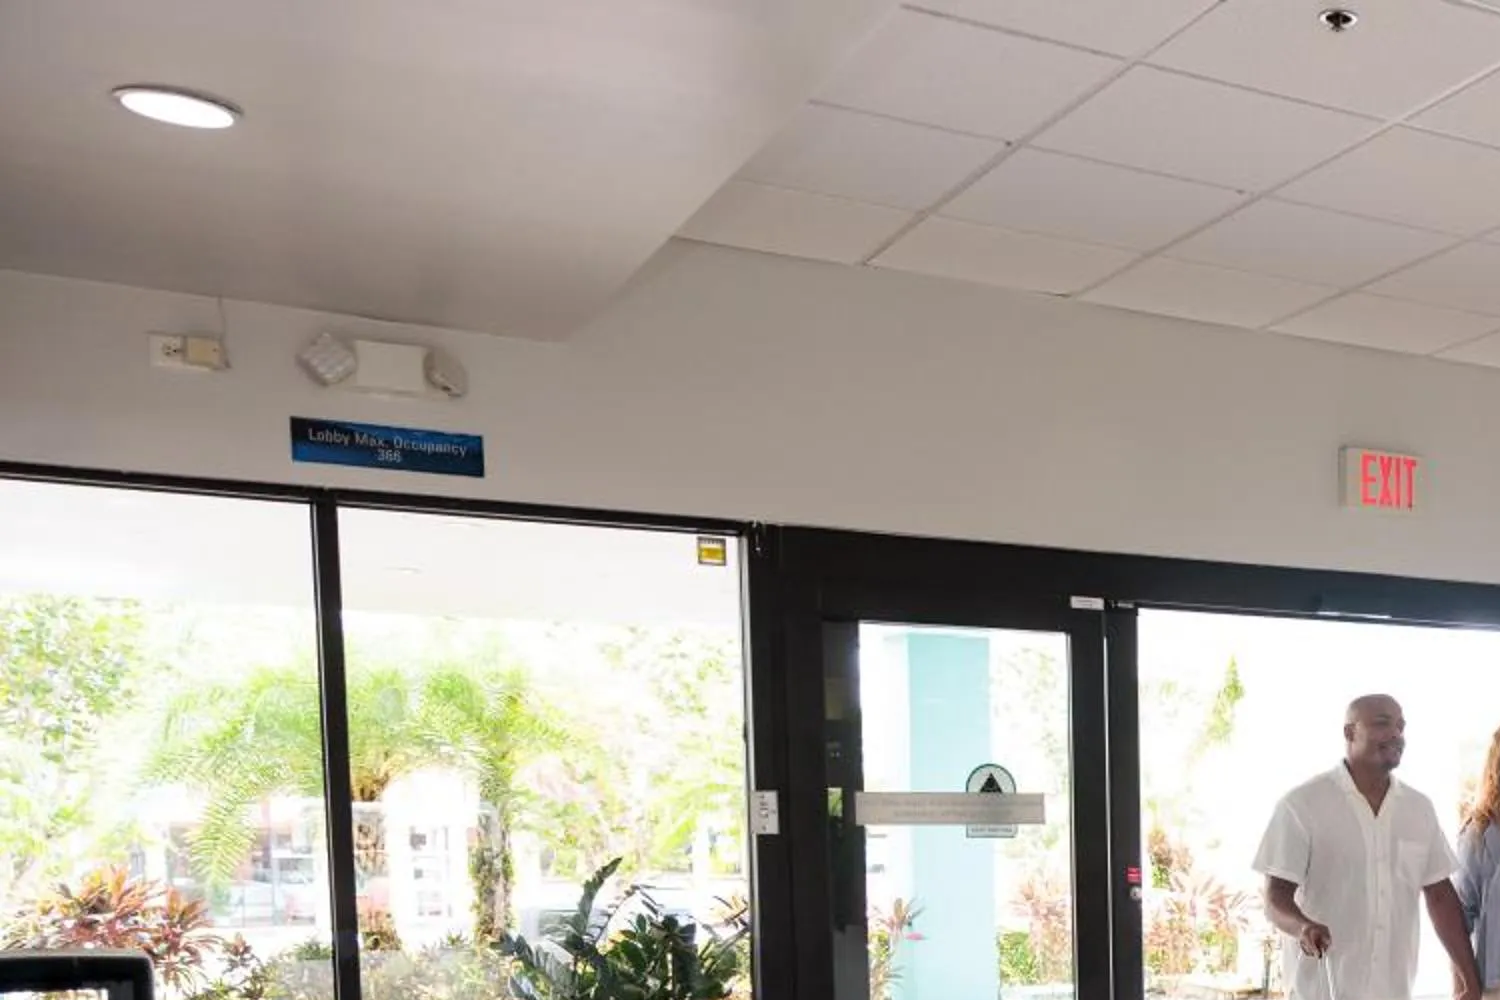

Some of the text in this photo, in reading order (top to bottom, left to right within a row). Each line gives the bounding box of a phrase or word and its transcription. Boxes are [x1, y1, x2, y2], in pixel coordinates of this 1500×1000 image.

[308, 428, 467, 456] Lobby Max. Occupancy
[1361, 453, 1417, 511] EXIT
